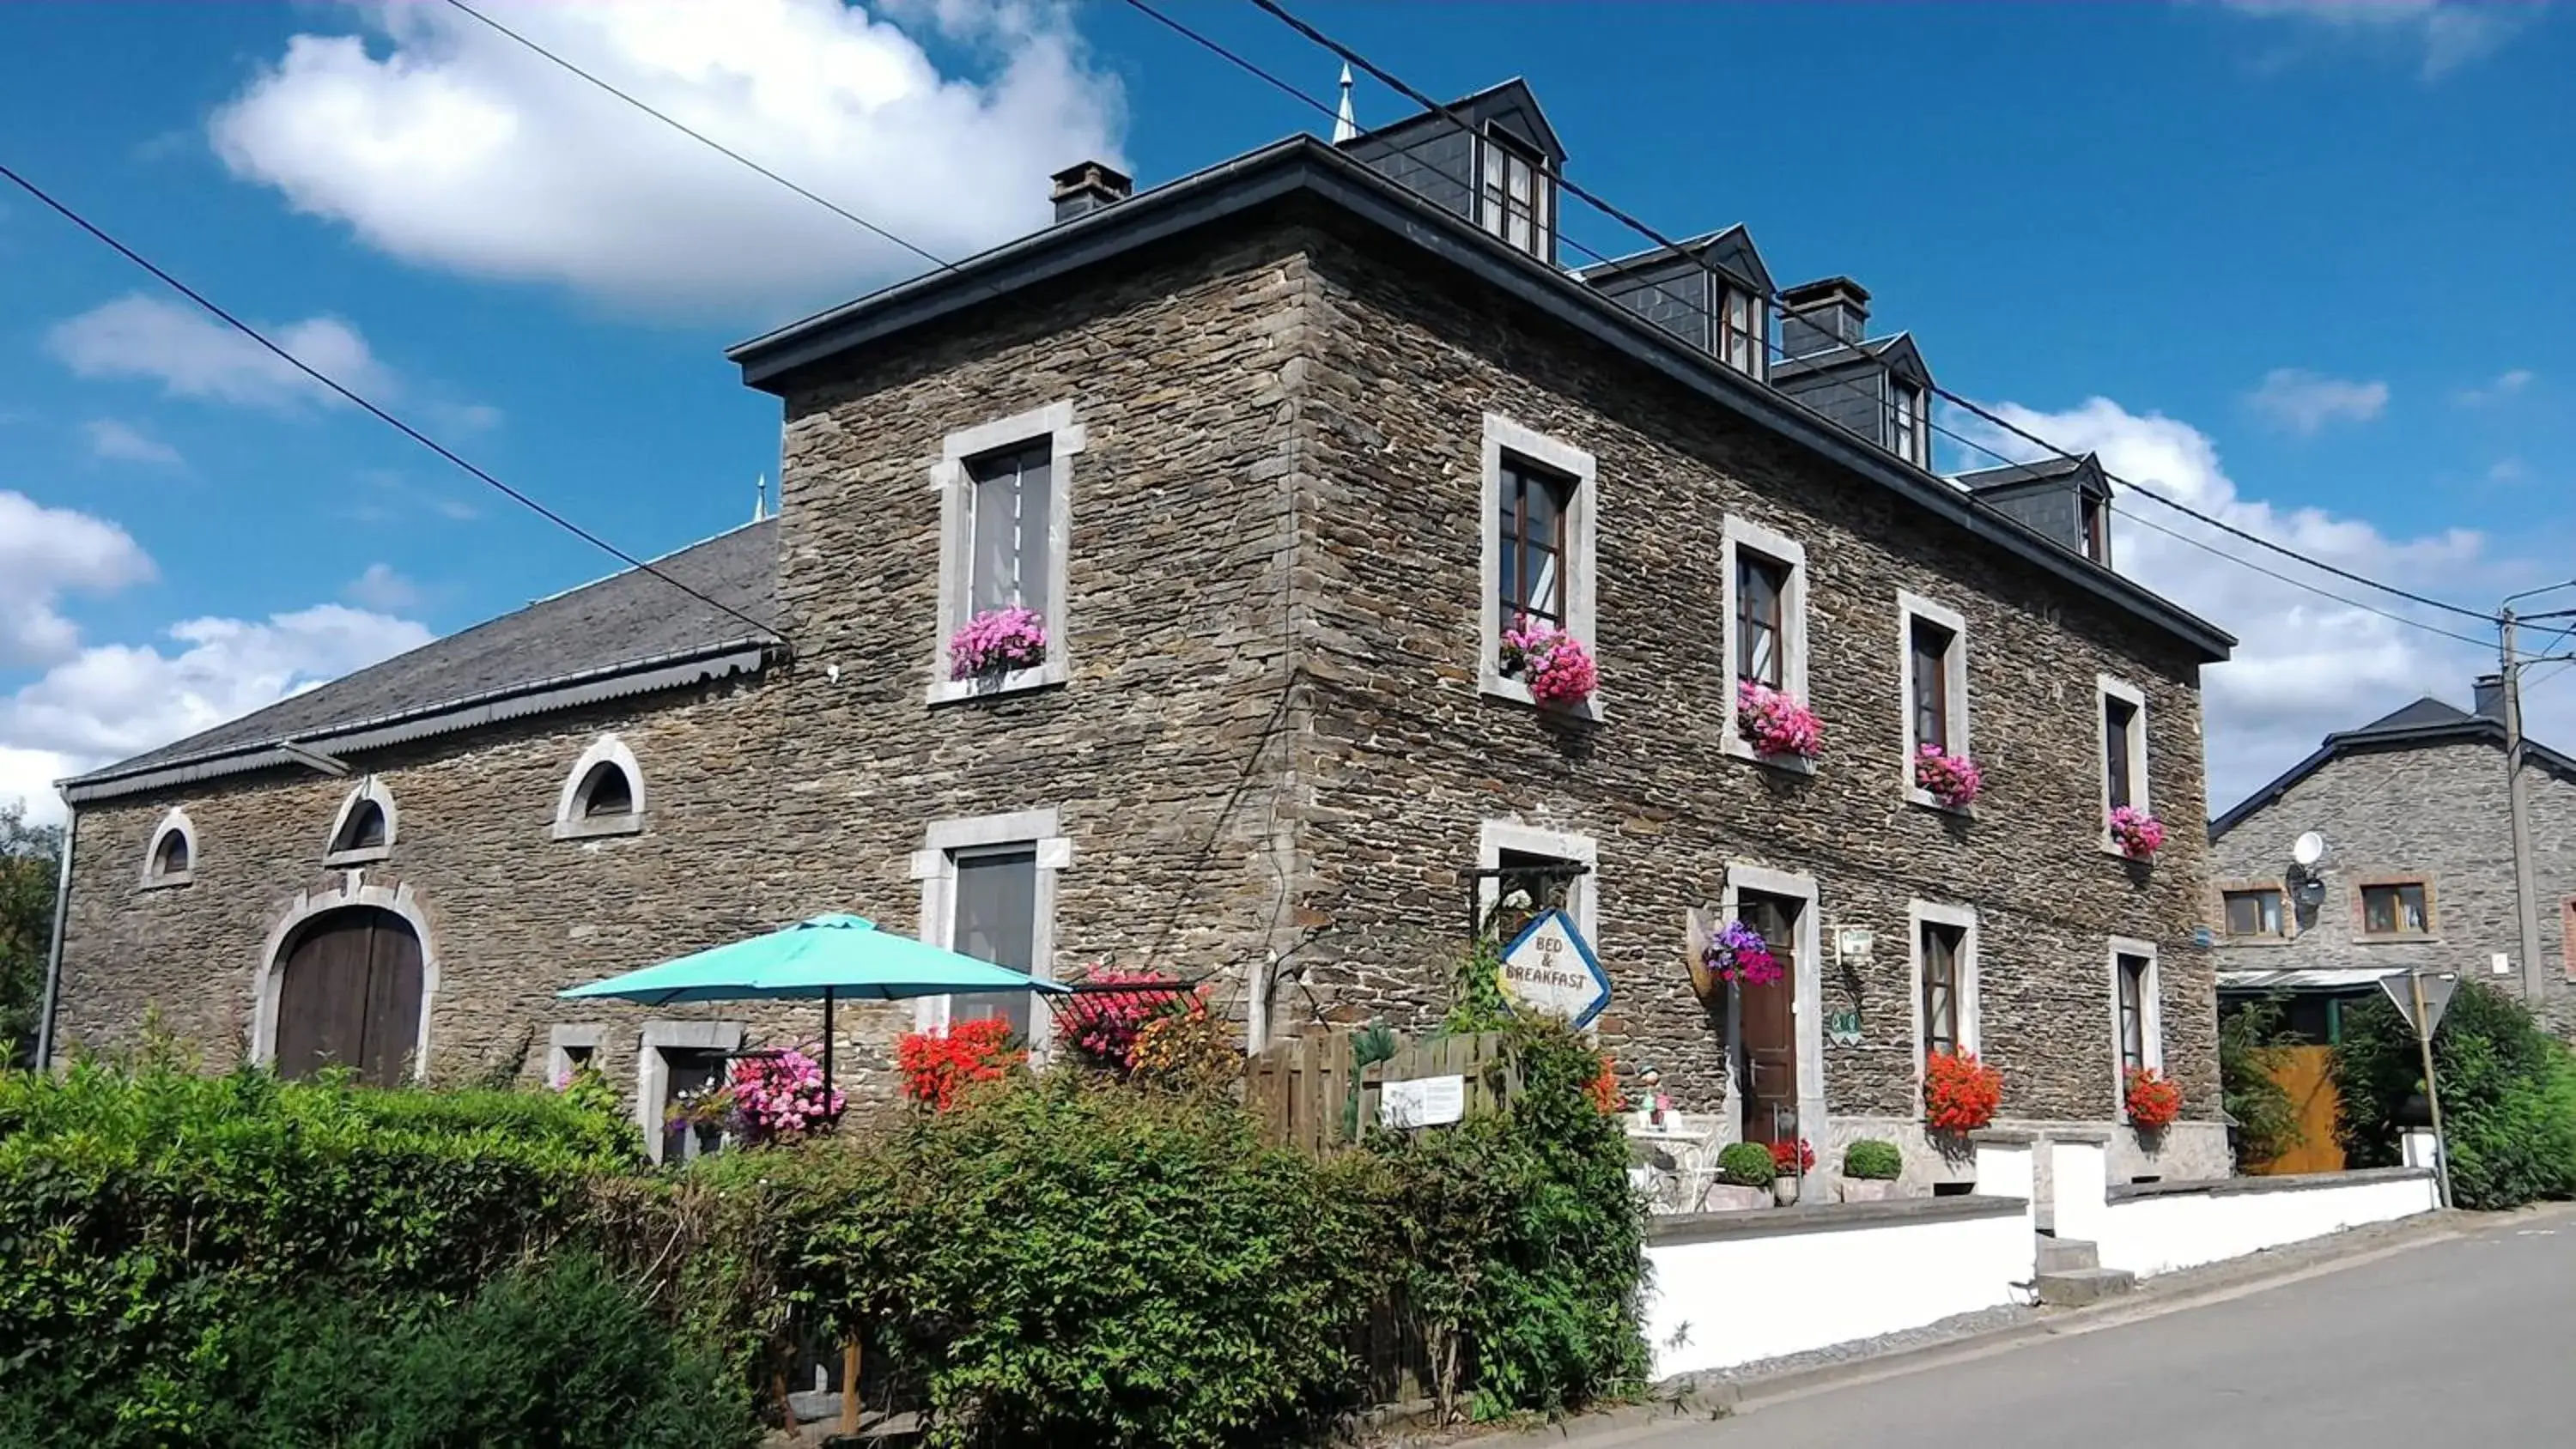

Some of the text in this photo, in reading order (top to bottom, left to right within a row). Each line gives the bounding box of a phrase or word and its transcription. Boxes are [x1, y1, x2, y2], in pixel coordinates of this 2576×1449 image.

[1535, 937, 1564, 953] BED
[1541, 955, 1553, 968] &
[1506, 967, 1587, 989] BREAKFAST
